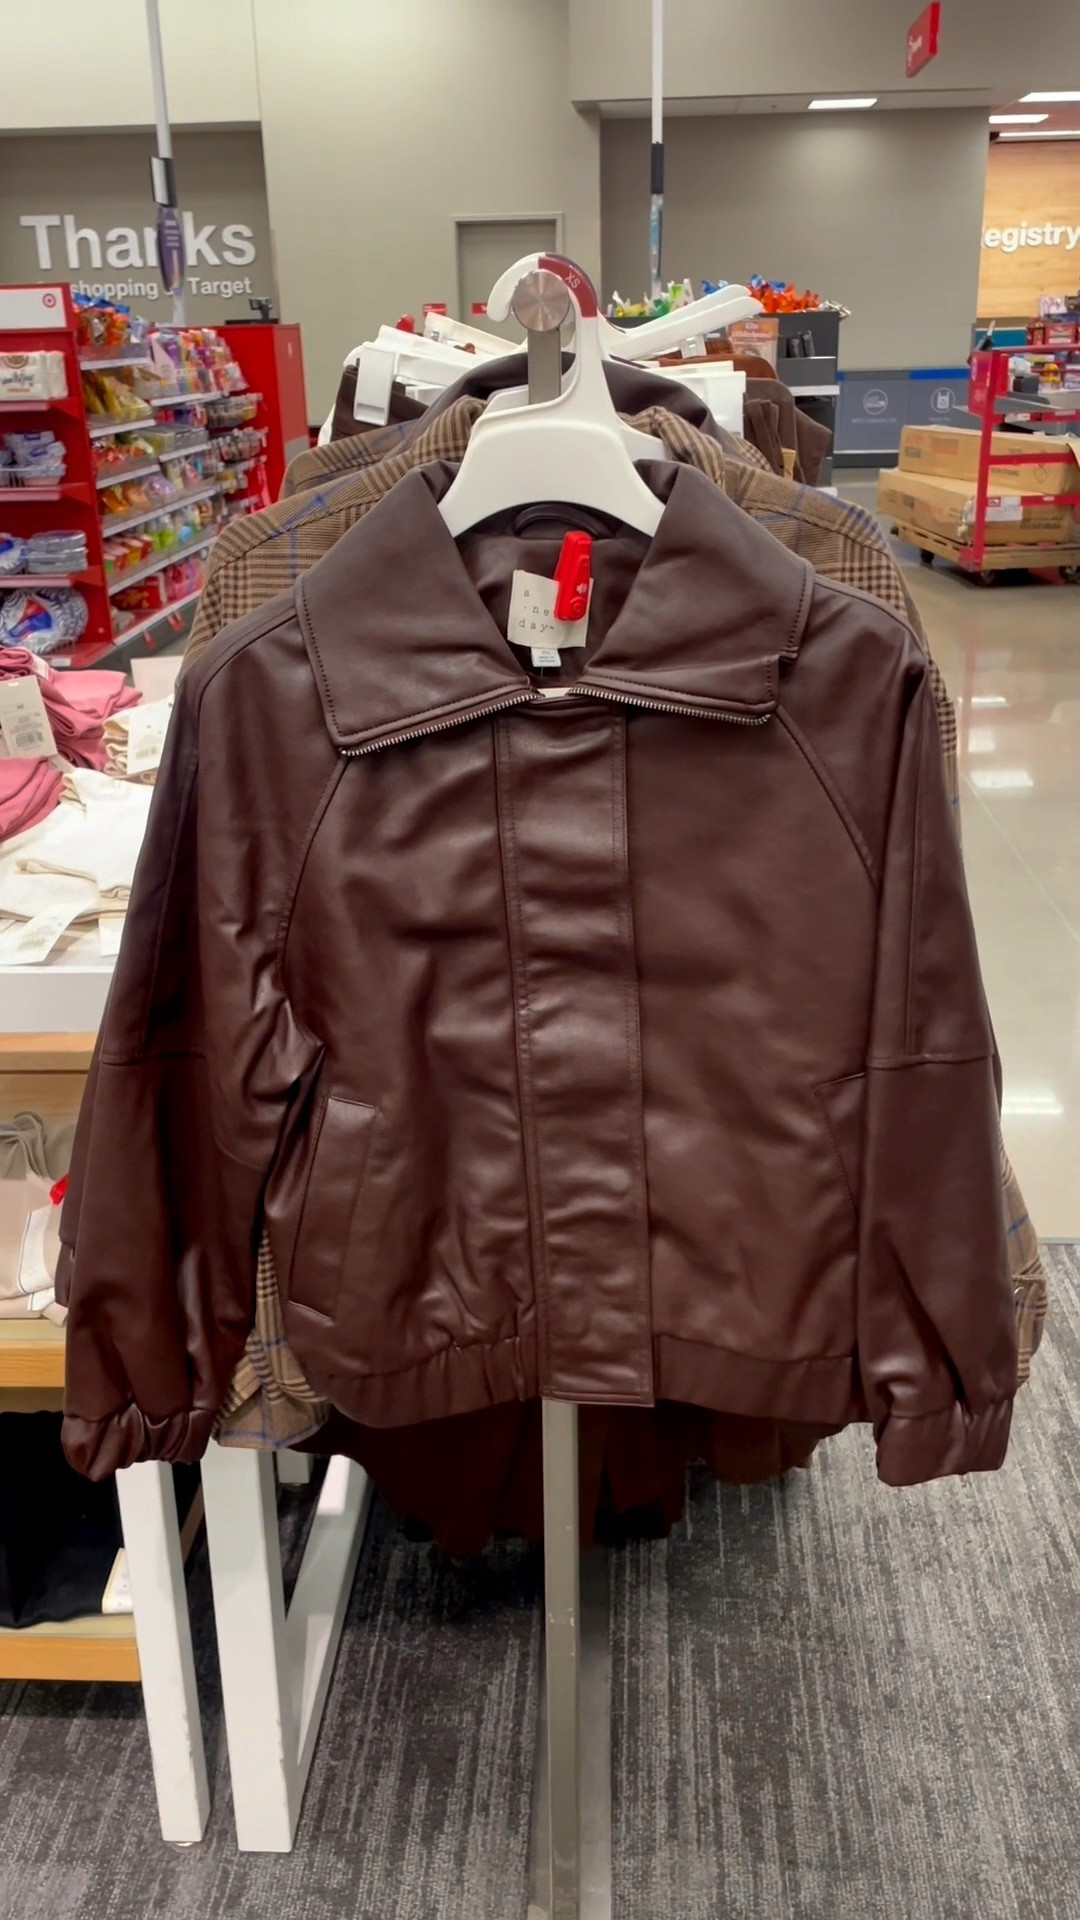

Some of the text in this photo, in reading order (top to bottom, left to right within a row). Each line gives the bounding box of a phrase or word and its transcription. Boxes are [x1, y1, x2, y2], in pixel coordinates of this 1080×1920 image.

[983, 220, 1080, 253] egistry
[71, 277, 252, 300] shopping Target
[565, 272, 581, 289] XS
